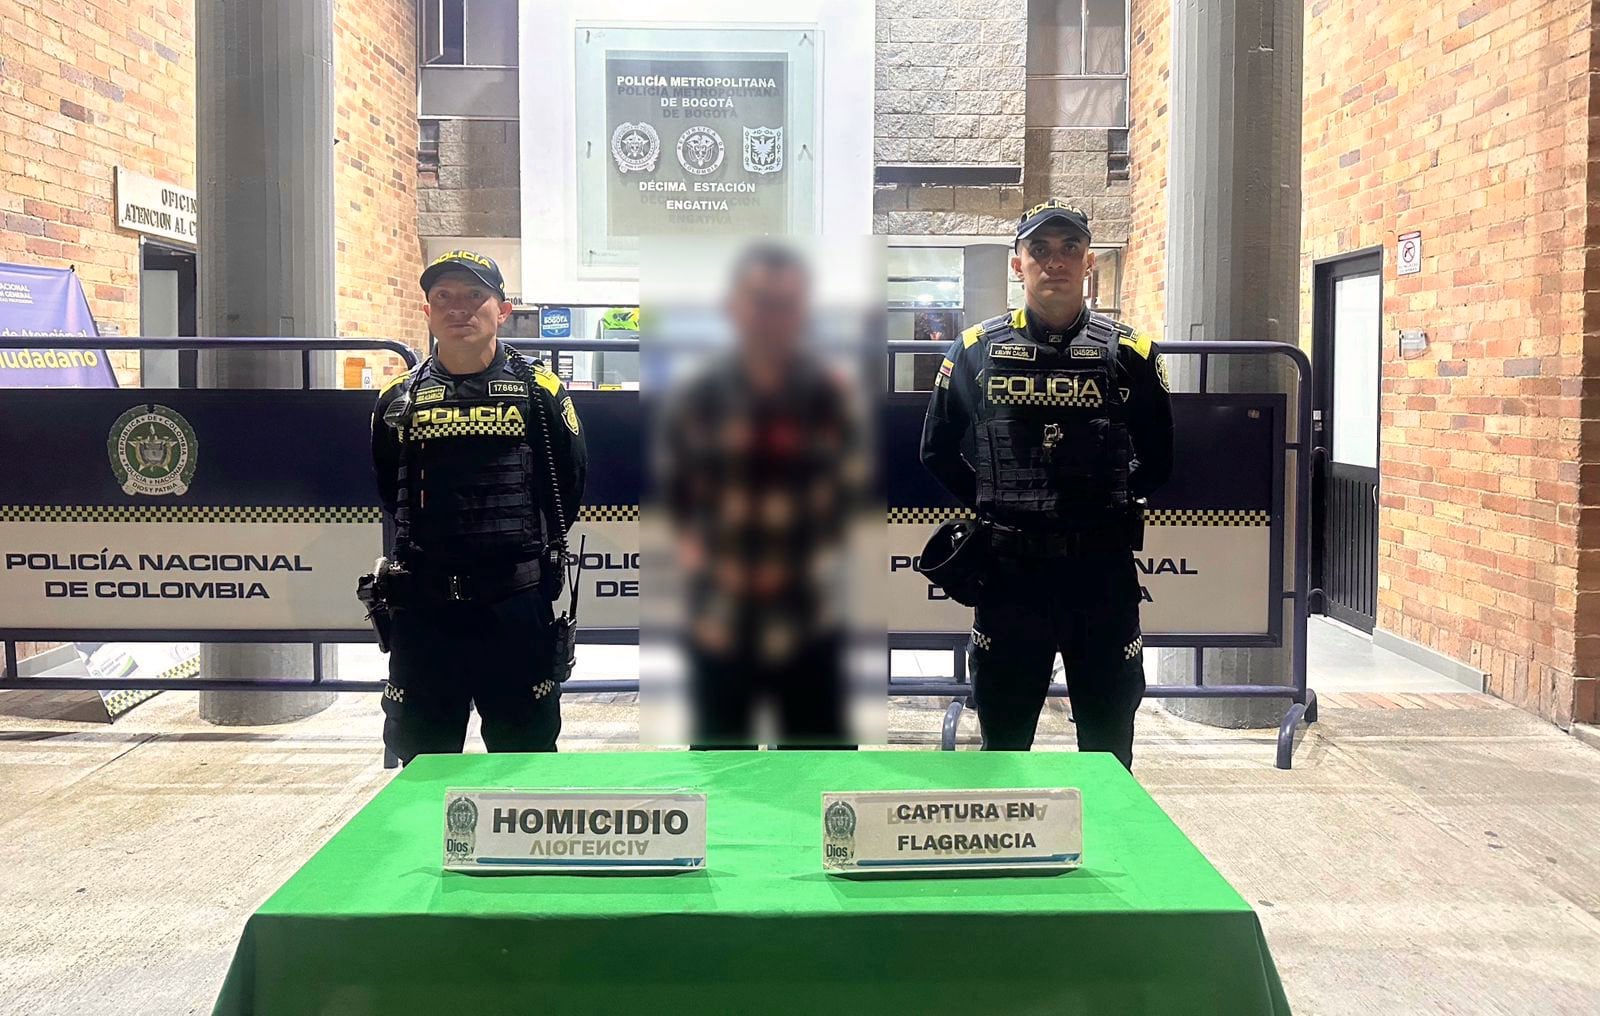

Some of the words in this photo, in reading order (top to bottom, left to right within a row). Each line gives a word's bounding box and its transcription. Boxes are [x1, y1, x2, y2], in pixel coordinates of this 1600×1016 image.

[617, 74, 668, 86] POLICÍA
[670, 77, 776, 88] METROPOLITANA
[660, 98, 678, 107] DE
[682, 97, 734, 108] BOGOTÁ
[639, 180, 687, 192] DÉCIMA
[694, 181, 756, 192] ESTACIÓN
[666, 200, 728, 210] ENGATIVÁ
[125, 203, 171, 230] ATENCION
[175, 217, 186, 234] AL
[988, 376, 1102, 398] POLICÍA
[412, 402, 524, 427] POLICÍA
[120, 420, 140, 456] REPUBLICA
[164, 420, 187, 456] COLOMBIA
[154, 464, 184, 484] NACIONAL
[6, 548, 132, 570] POLICÍA
[140, 554, 312, 572] NACIONAL
[46, 582, 88, 598] DE
[94, 582, 270, 598] COLOMBIA
[596, 581, 640, 598] DE
[896, 803, 1000, 820] CAPTURA
[1006, 802, 1034, 818] EN
[492, 808, 689, 835] HOMICIDIO
[447, 838, 468, 852] Dios
[897, 833, 1036, 850] FLAGRANCIA
[826, 844, 848, 858] Dios
